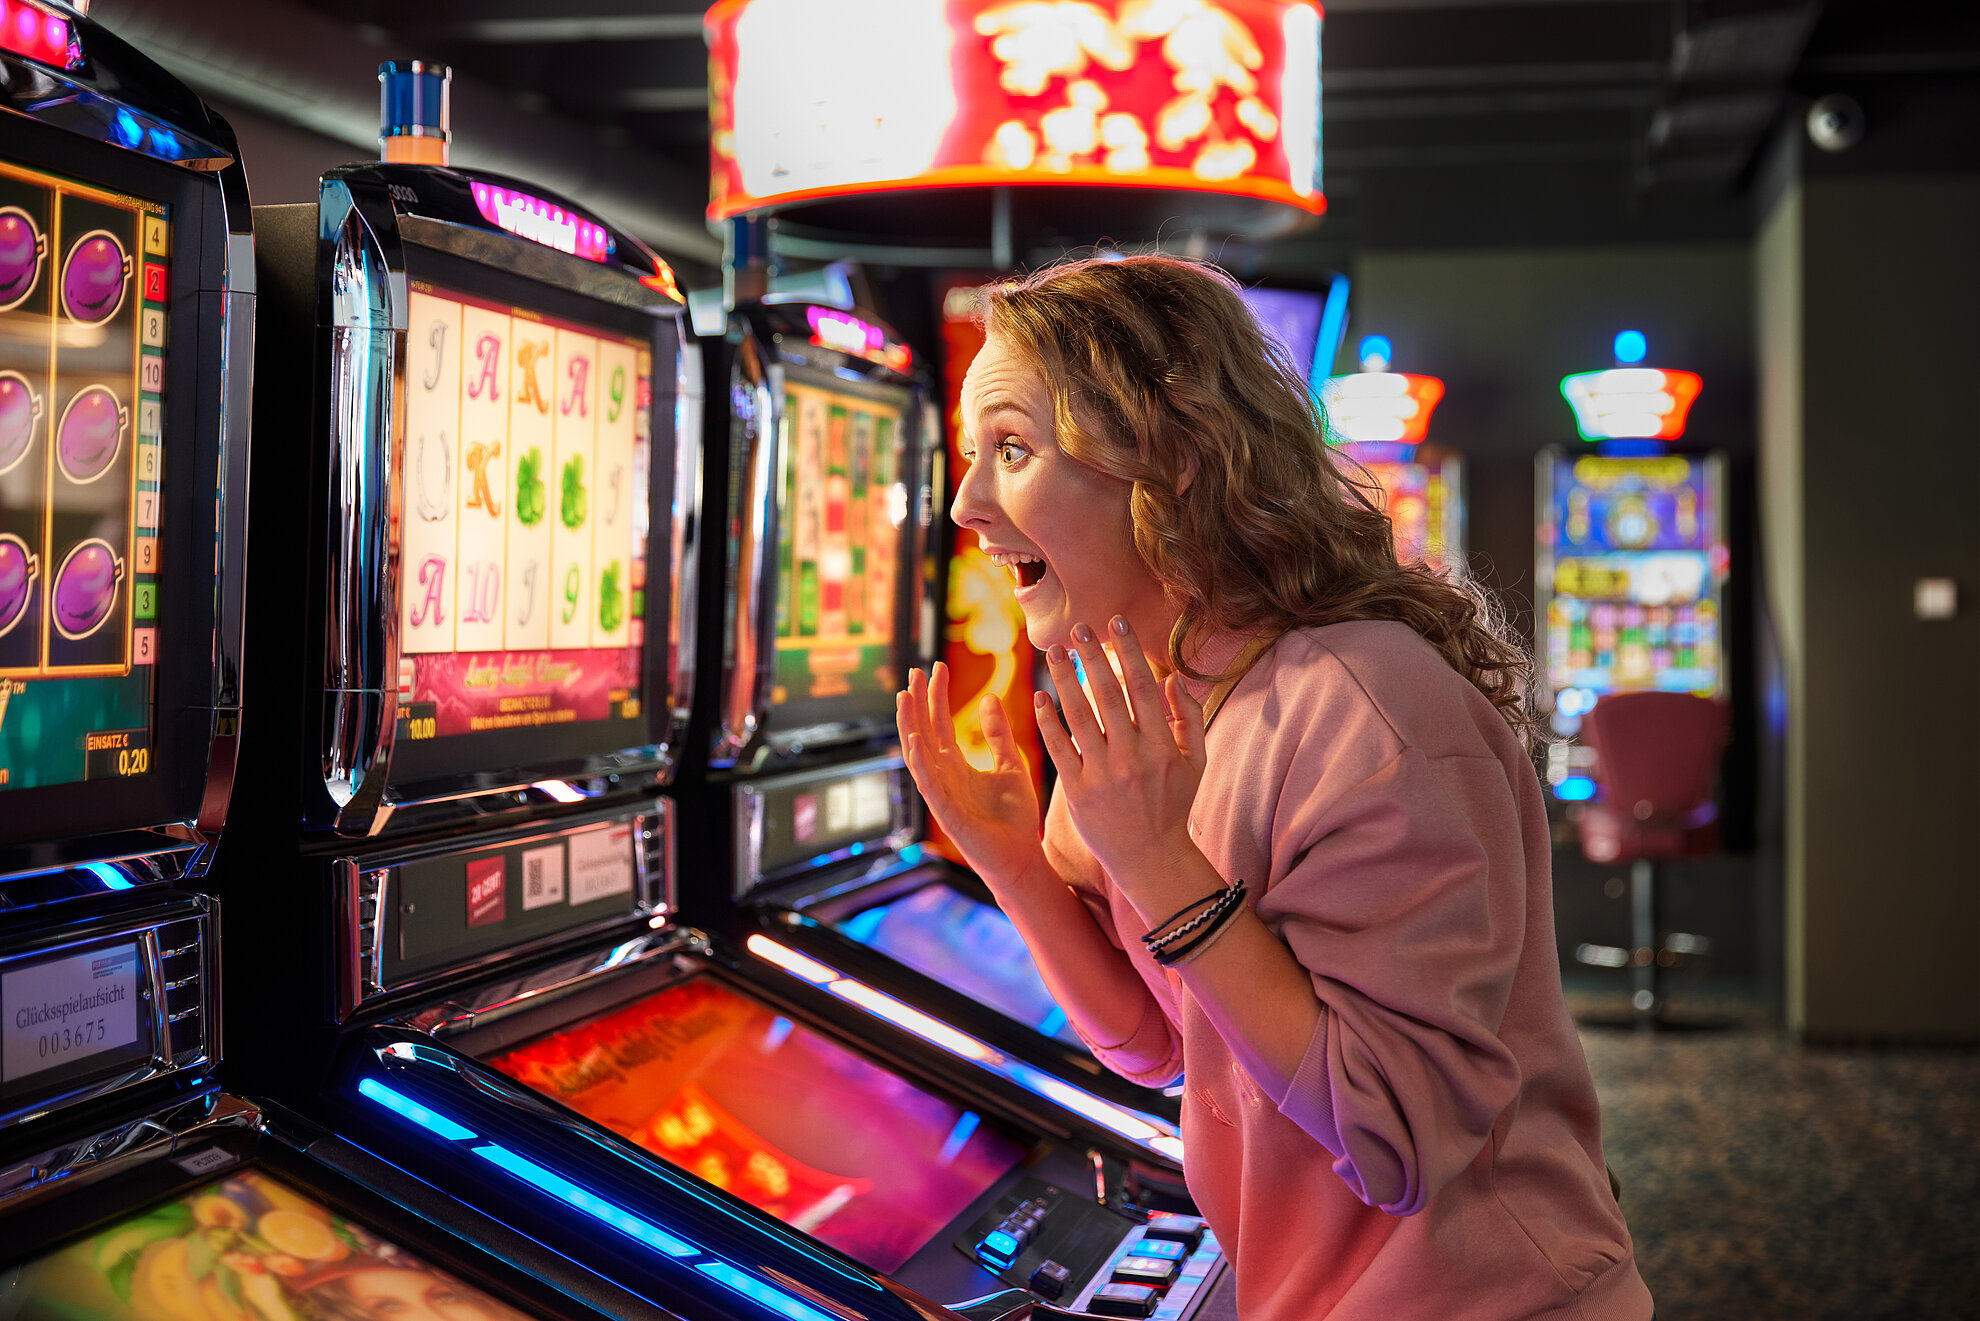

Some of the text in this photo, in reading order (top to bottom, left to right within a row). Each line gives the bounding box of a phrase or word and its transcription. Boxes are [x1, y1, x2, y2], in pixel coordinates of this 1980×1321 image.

[116, 193, 155, 213] AUSZAHLUNG
[151, 225, 160, 247] 4
[150, 271, 160, 293] 2
[149, 317, 158, 338] 8
[145, 363, 160, 385] 10
[467, 333, 501, 403] A
[561, 355, 590, 418] A
[607, 364, 626, 424] 9
[146, 409, 154, 430] 1
[145, 452, 153, 473] 6
[145, 499, 152, 519] 7
[143, 544, 151, 565] 9
[142, 590, 150, 610] 3
[410, 555, 447, 628] A
[462, 561, 500, 624] 10
[561, 561, 581, 625] 9
[140, 636, 149, 656] 5
[88, 733, 129, 751] EINSATZ €
[118, 748, 148, 777] 0,20
[15, 984, 125, 1030] Glücksspielaufsicht
[38, 1018, 106, 1058] 003675
